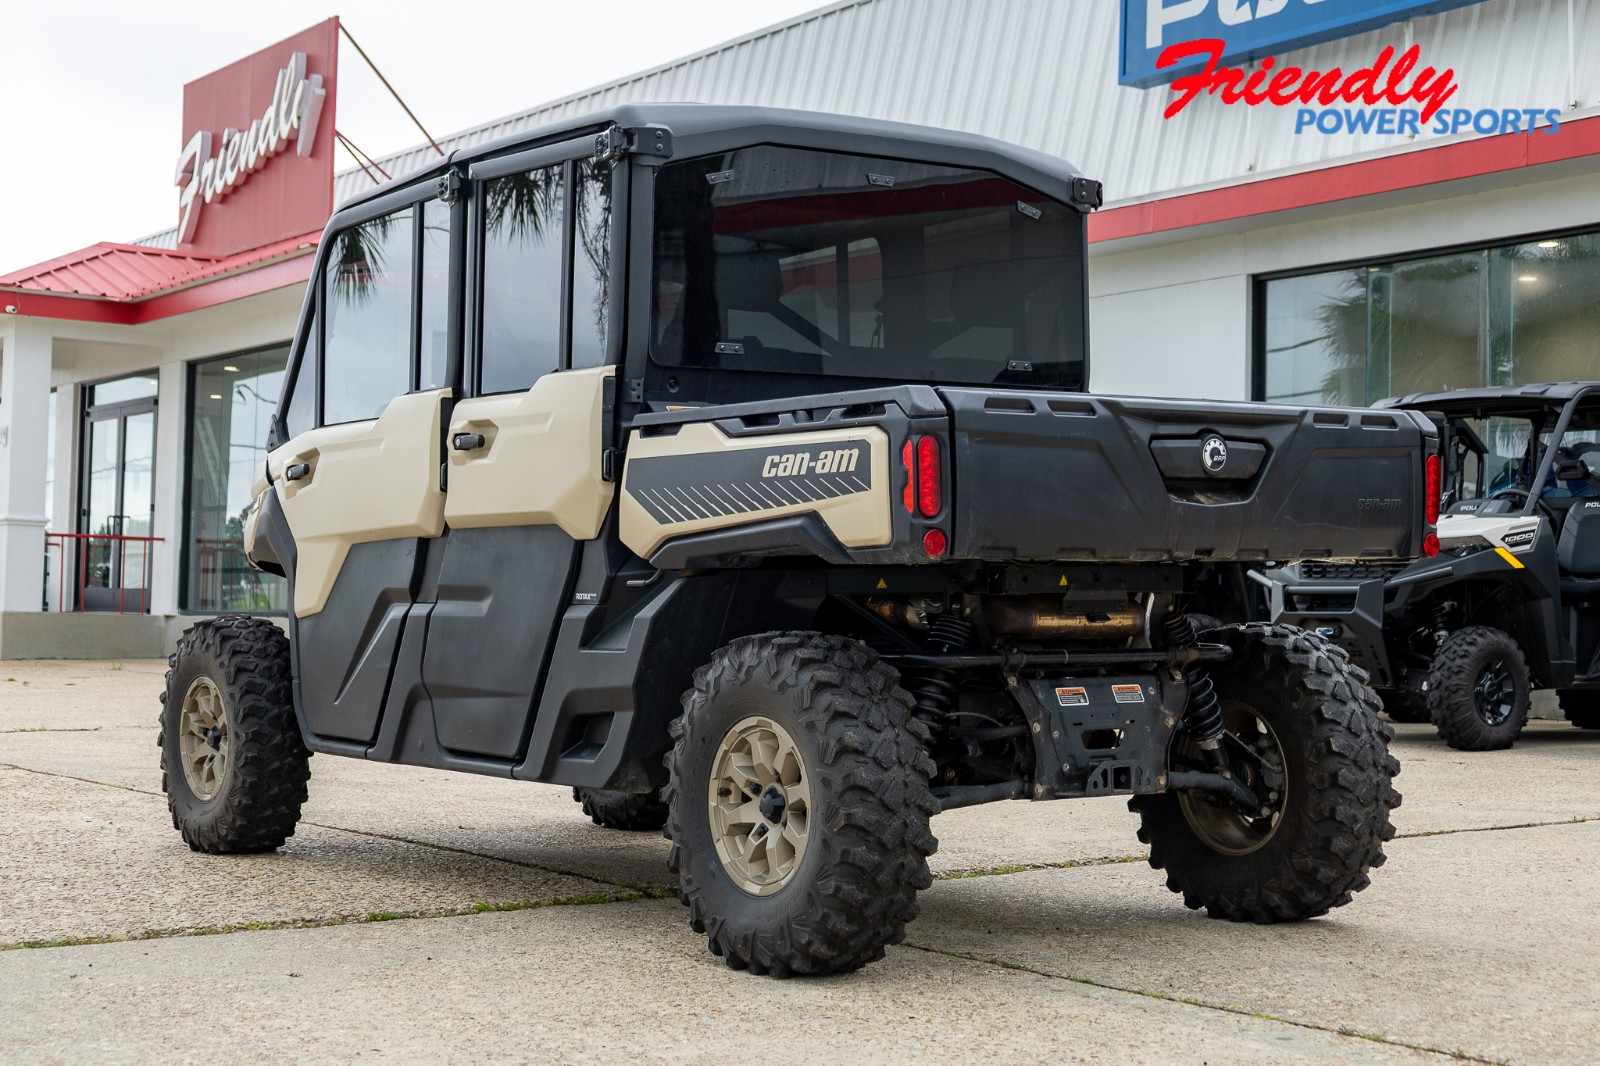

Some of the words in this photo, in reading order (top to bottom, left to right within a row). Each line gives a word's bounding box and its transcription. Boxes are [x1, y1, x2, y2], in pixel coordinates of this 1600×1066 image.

[174, 51, 326, 244] Friendly
[762, 448, 859, 478] can-am
[1504, 532, 1534, 543] 1000
